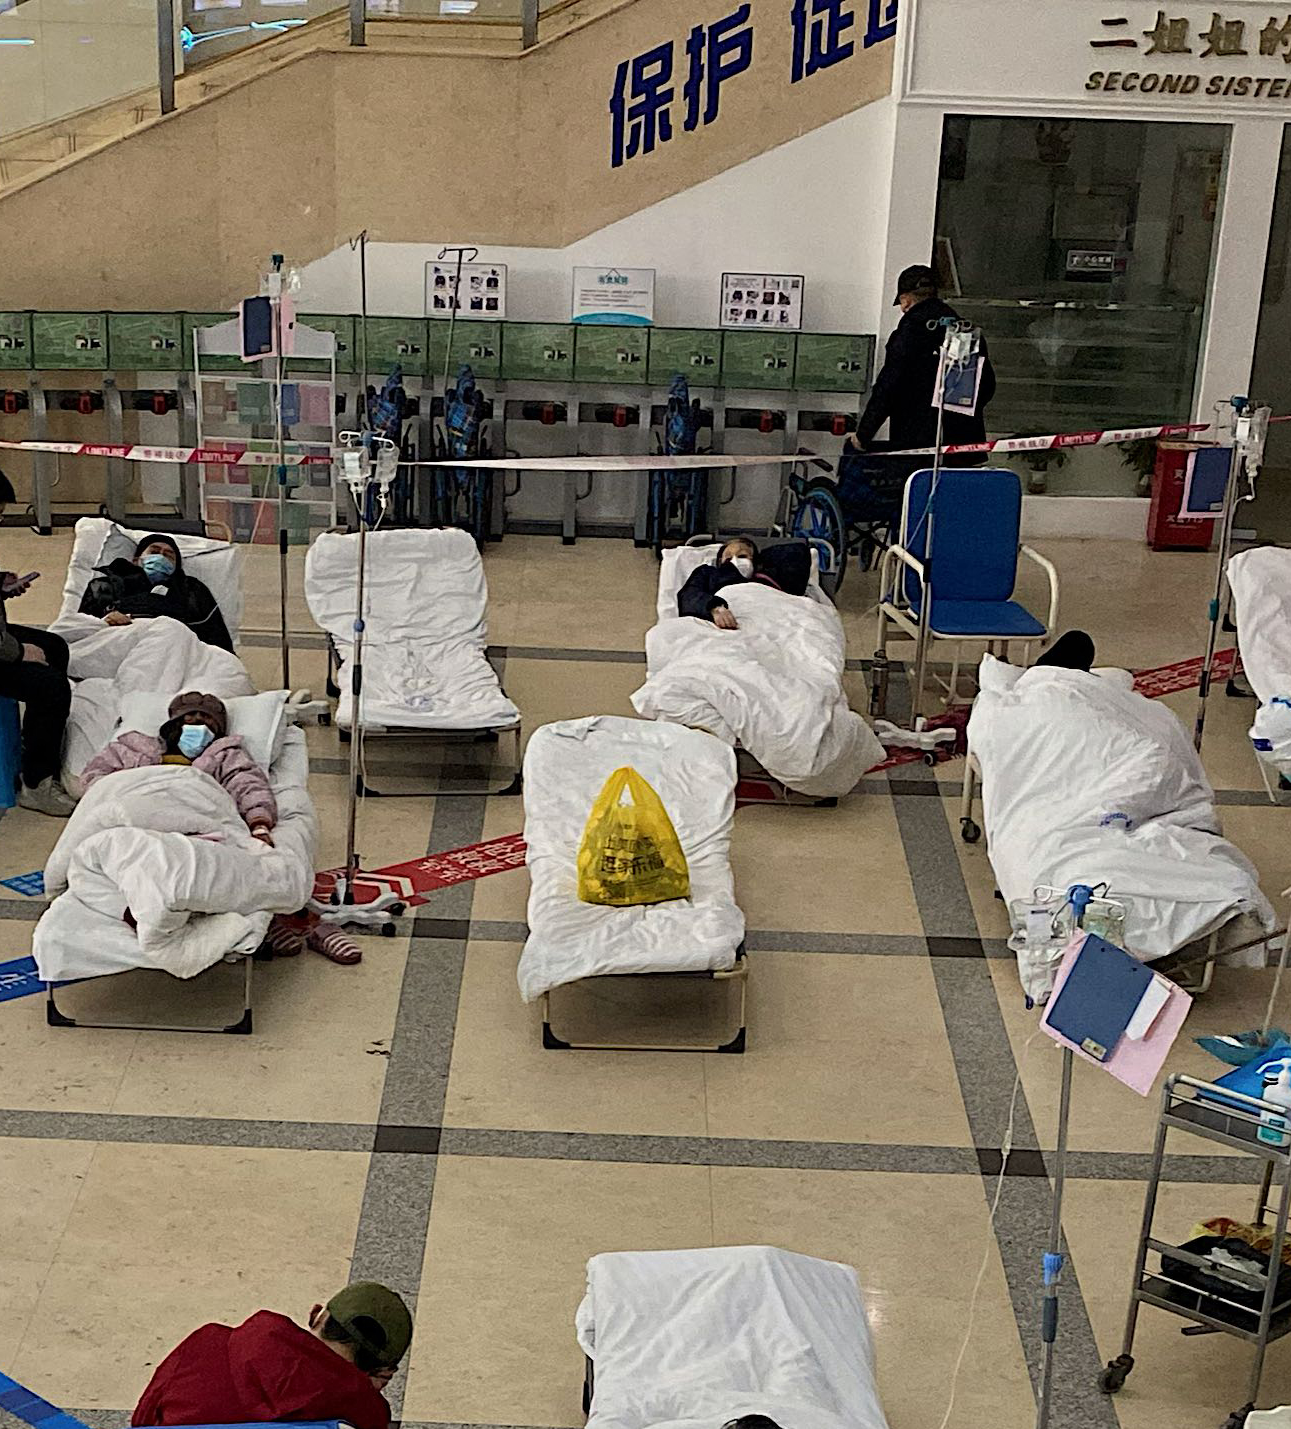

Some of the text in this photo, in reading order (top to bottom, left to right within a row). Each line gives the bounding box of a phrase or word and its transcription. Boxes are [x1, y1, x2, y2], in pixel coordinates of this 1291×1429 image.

[609, 0, 898, 168] 保护 促
[1085, 71, 1200, 95] SECOND
[85, 446, 125, 457] LIMITLINE
